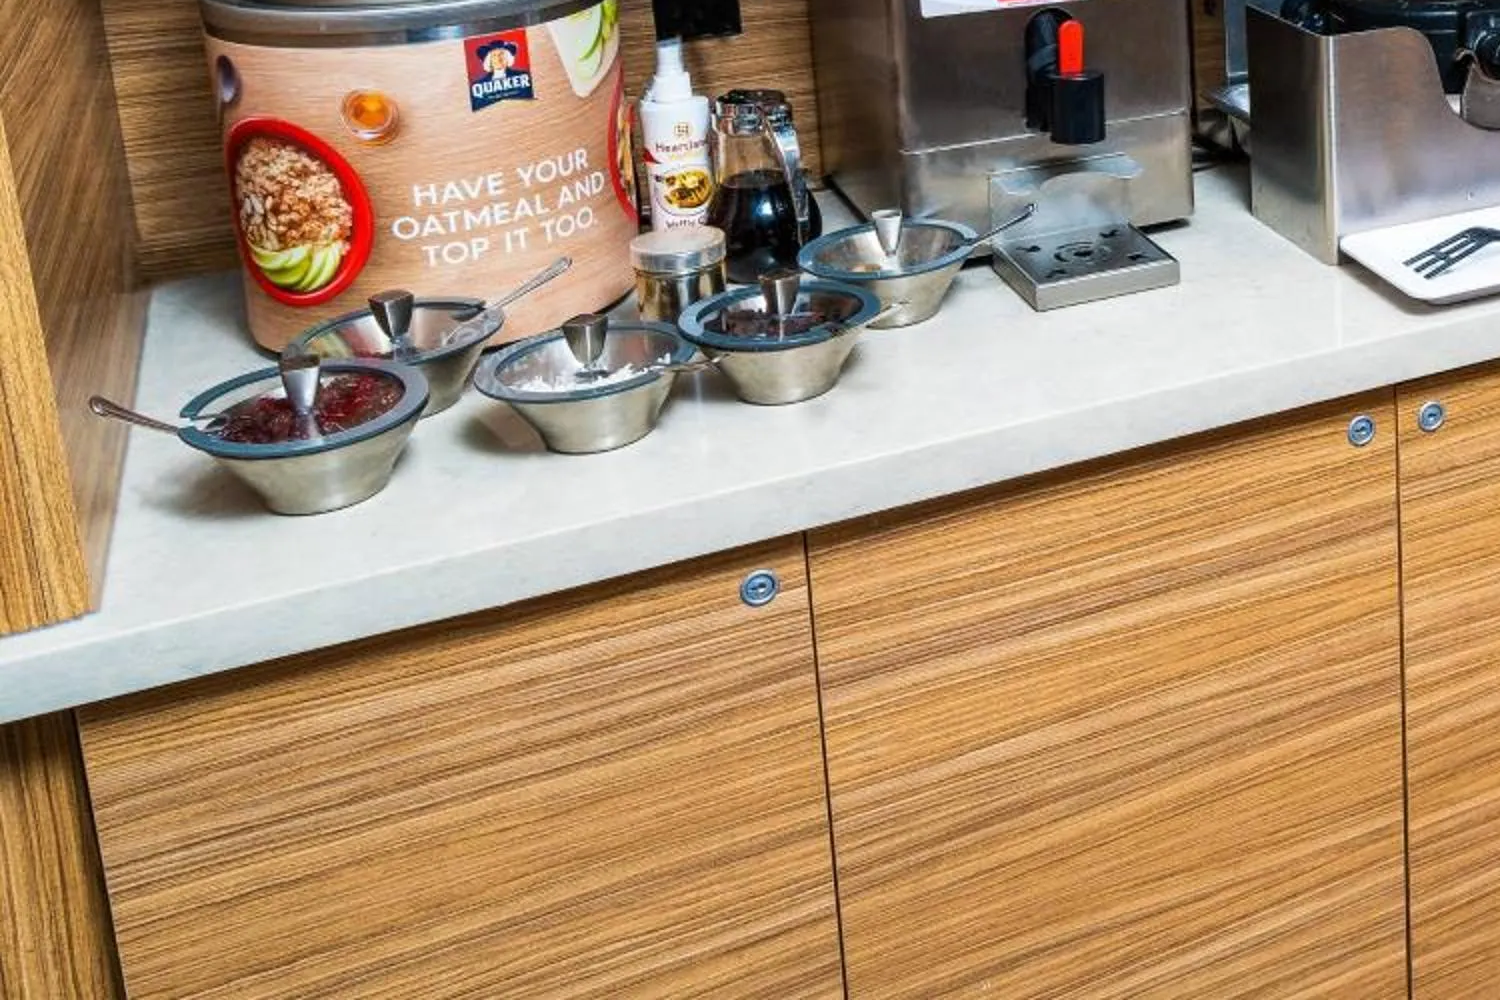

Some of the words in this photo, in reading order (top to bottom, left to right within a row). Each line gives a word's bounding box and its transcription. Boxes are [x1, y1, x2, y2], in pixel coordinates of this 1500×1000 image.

[472, 73, 531, 98] QUAKER
[655, 139, 706, 153] Heartlan
[391, 195, 549, 240] OATMEAL
[558, 171, 605, 209] AND
[412, 171, 504, 208] HAVE
[517, 148, 589, 188] YOUR
[421, 236, 490, 268] TOP
[505, 227, 530, 254] IT
[540, 206, 599, 244] TOO.
